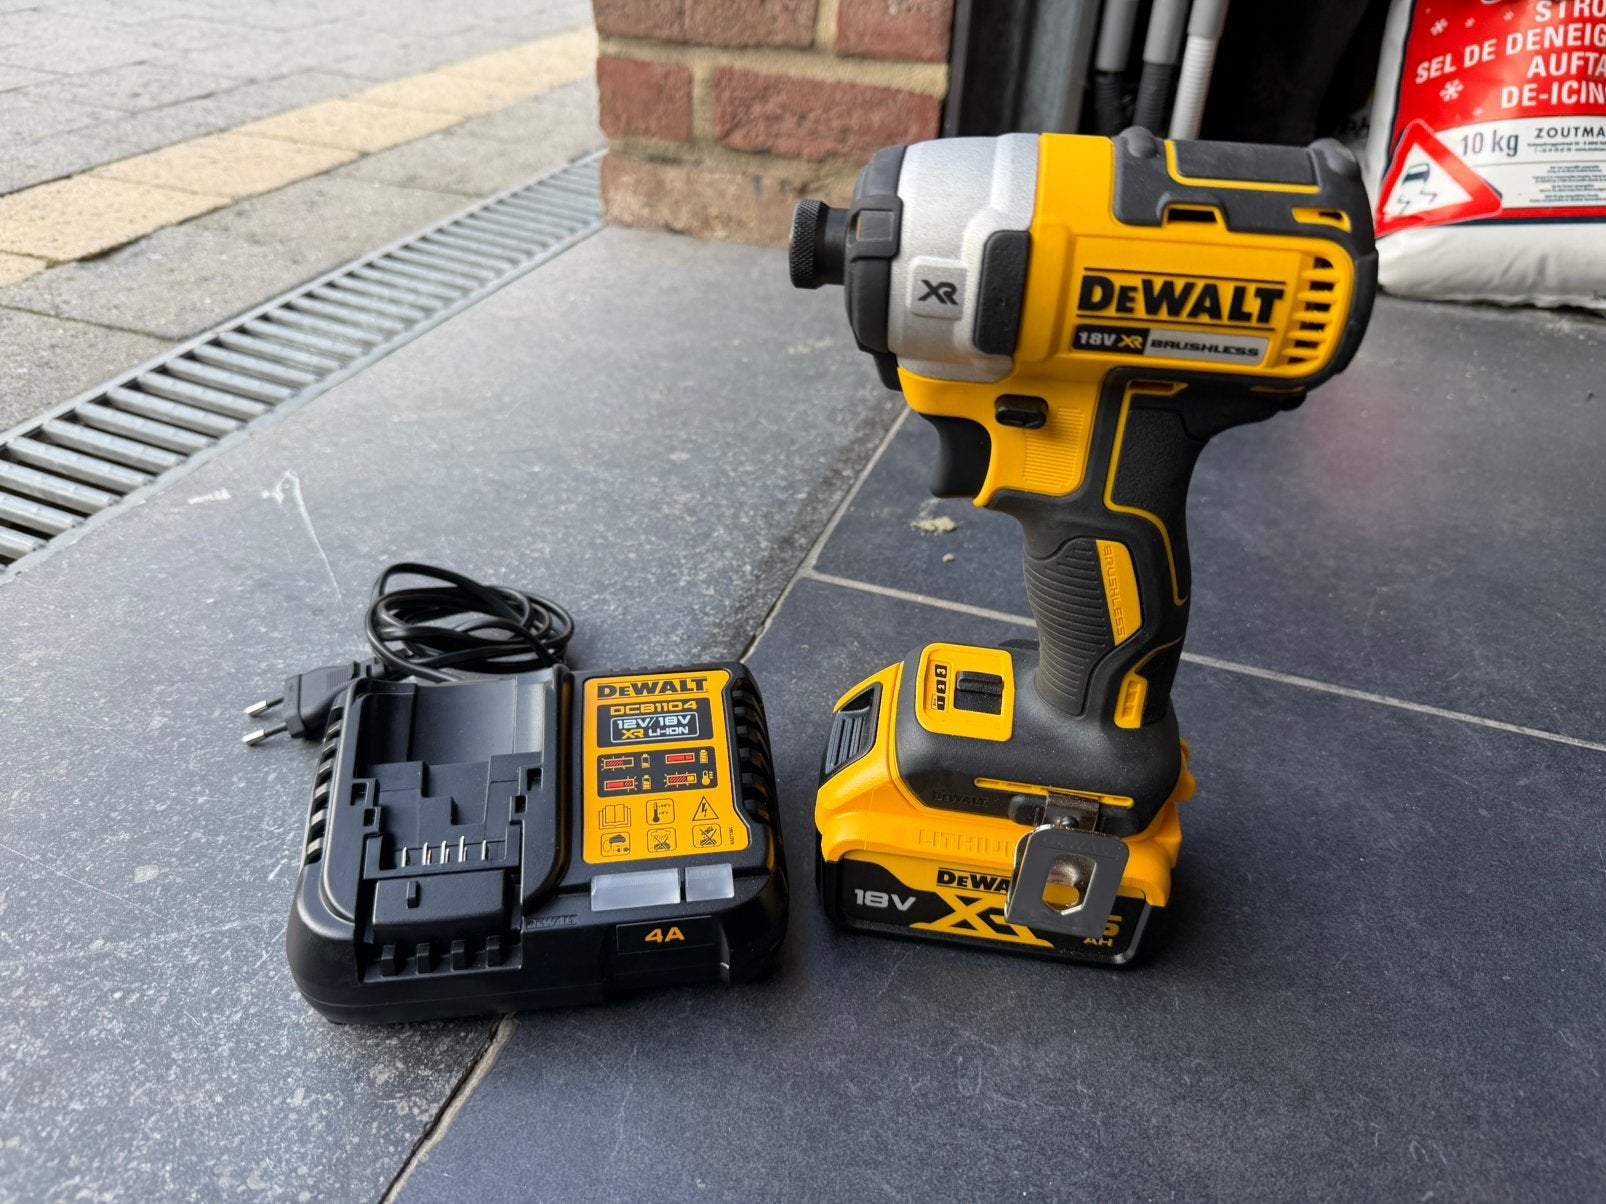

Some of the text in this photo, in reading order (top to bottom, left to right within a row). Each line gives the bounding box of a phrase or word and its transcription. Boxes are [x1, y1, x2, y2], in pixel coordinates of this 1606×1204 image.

[1416, 23, 1606, 84] SEL DE DENEIG
[1501, 80, 1606, 109] DE-ICIN
[1535, 126, 1606, 138] ZOUTMA
[1461, 129, 1519, 157] 10 kg
[918, 279, 959, 306] XR
[1078, 275, 1285, 323] DEWALT
[1078, 331, 1143, 349] 18V XR
[1151, 339, 1259, 356] BRUSHLESS
[1103, 545, 1126, 636] BRUSHLESS
[597, 678, 708, 698] DEWALT
[610, 701, 698, 715] DCB1104
[617, 715, 691, 729] 12V/18V
[621, 726, 688, 739] XR LI-ION
[855, 889, 917, 911] 18V
[645, 926, 686, 943] 4A
